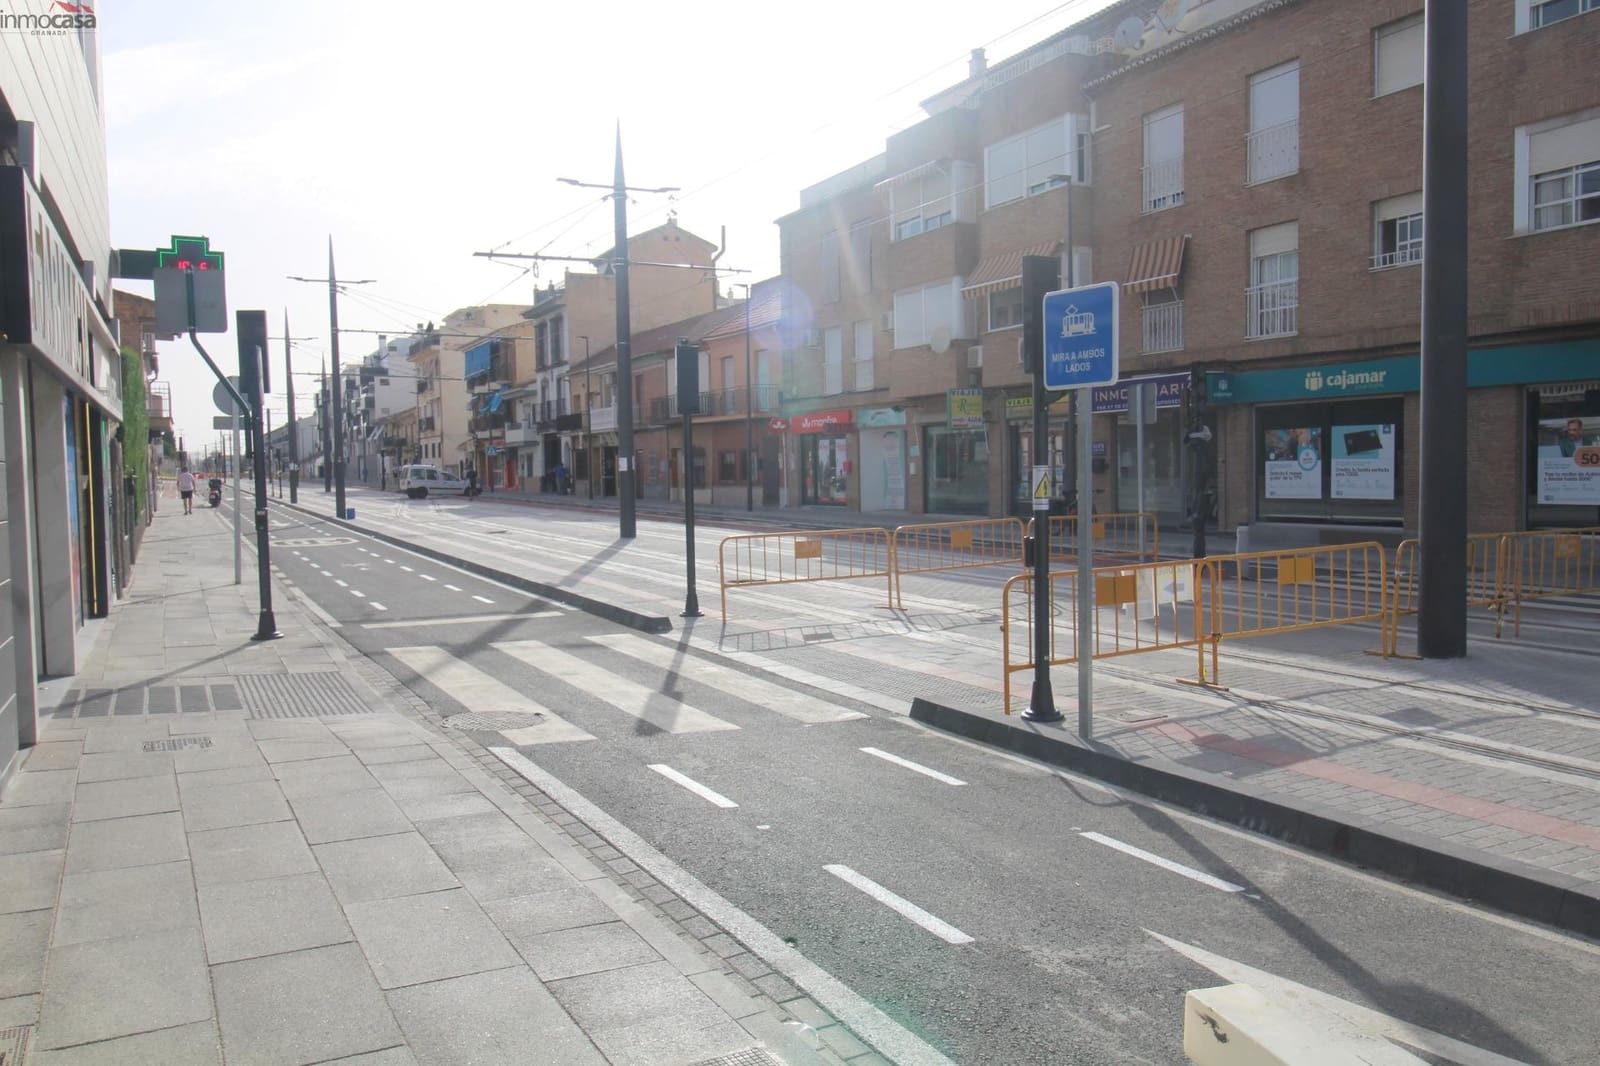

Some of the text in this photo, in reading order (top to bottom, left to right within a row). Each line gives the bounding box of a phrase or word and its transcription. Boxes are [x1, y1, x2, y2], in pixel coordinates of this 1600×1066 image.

[1052, 347, 1105, 362] MIRA A AMBOS
[1065, 362, 1091, 373] LADOS
[1326, 370, 1387, 390] cajamar
